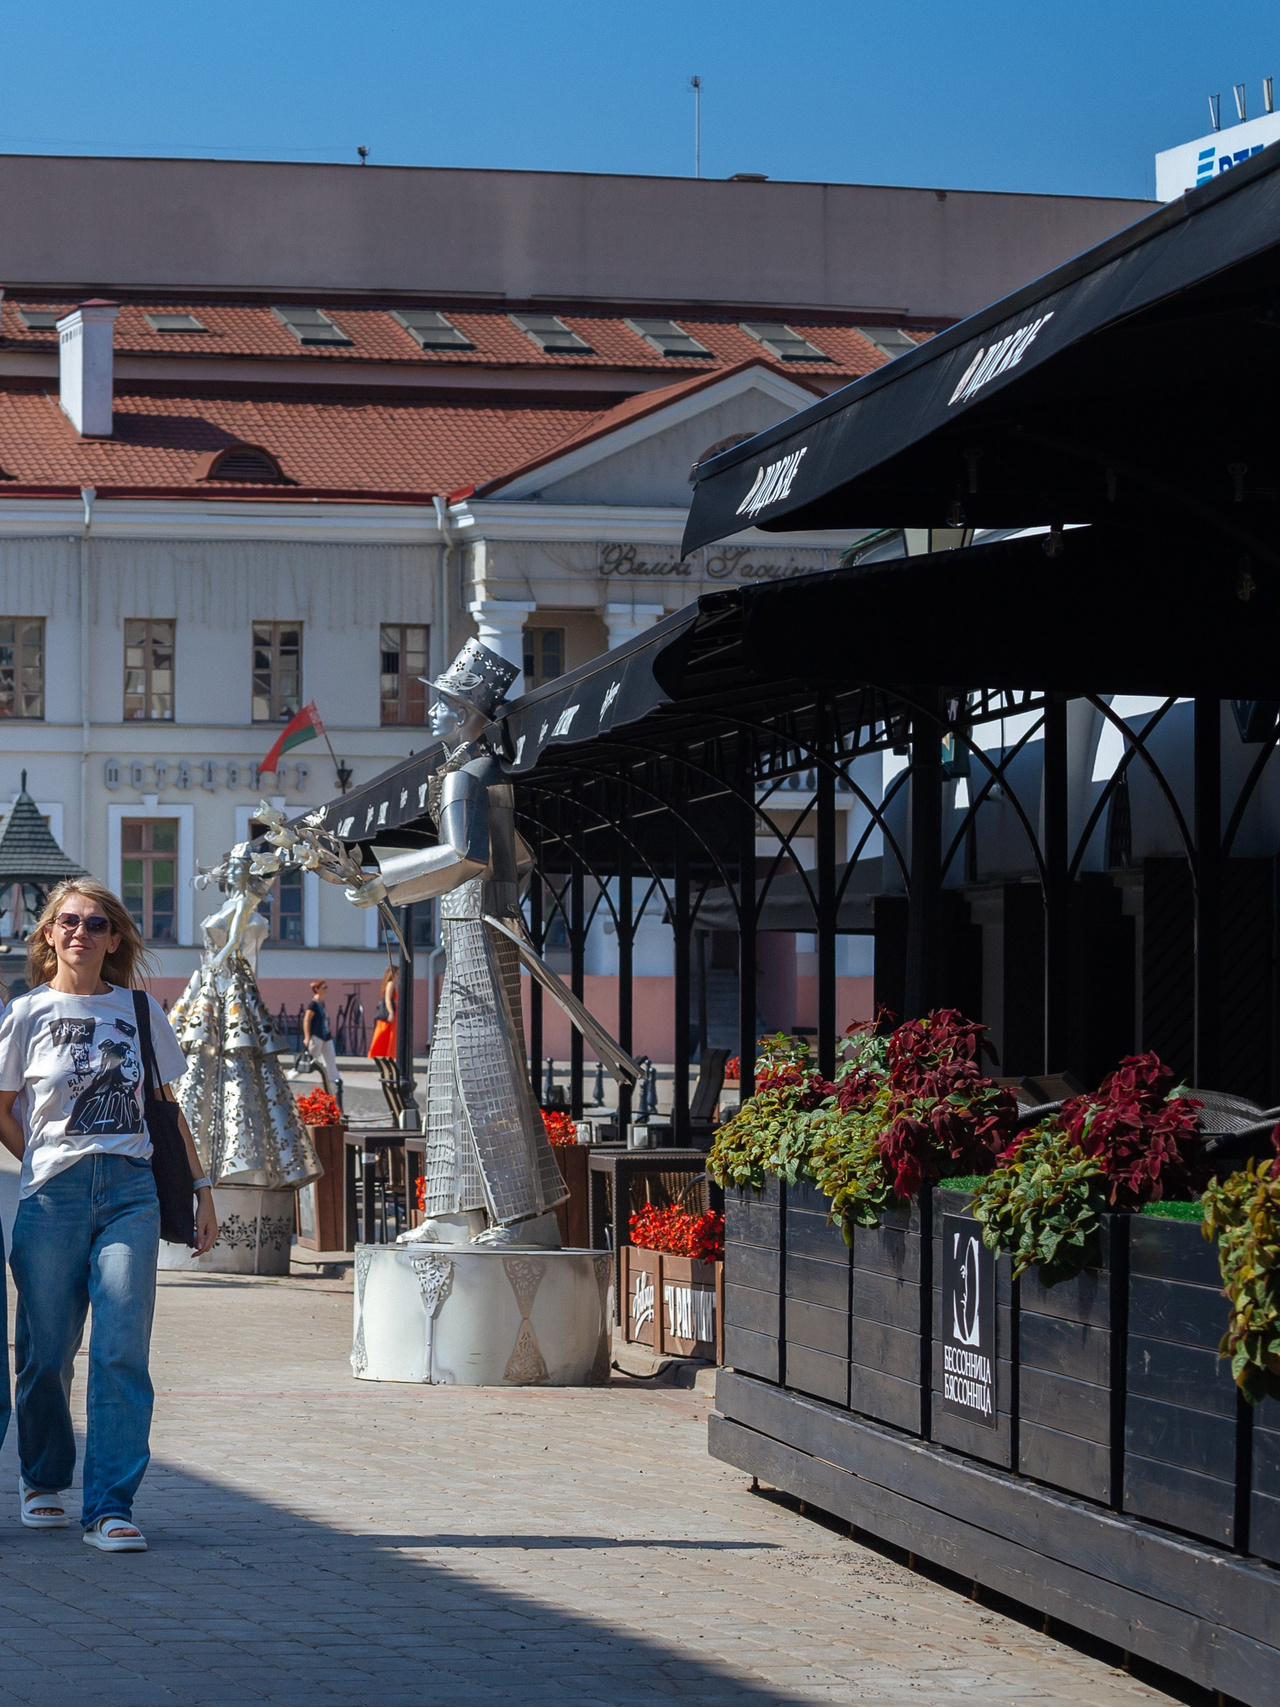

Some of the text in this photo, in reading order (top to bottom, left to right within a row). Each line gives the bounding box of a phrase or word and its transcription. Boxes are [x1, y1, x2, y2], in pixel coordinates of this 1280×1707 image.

[67, 1075, 84, 1087] BLA
[943, 1345, 992, 1385] БЕССОННИЦА
[943, 1373, 992, 1417] БЯССОННІЦА
